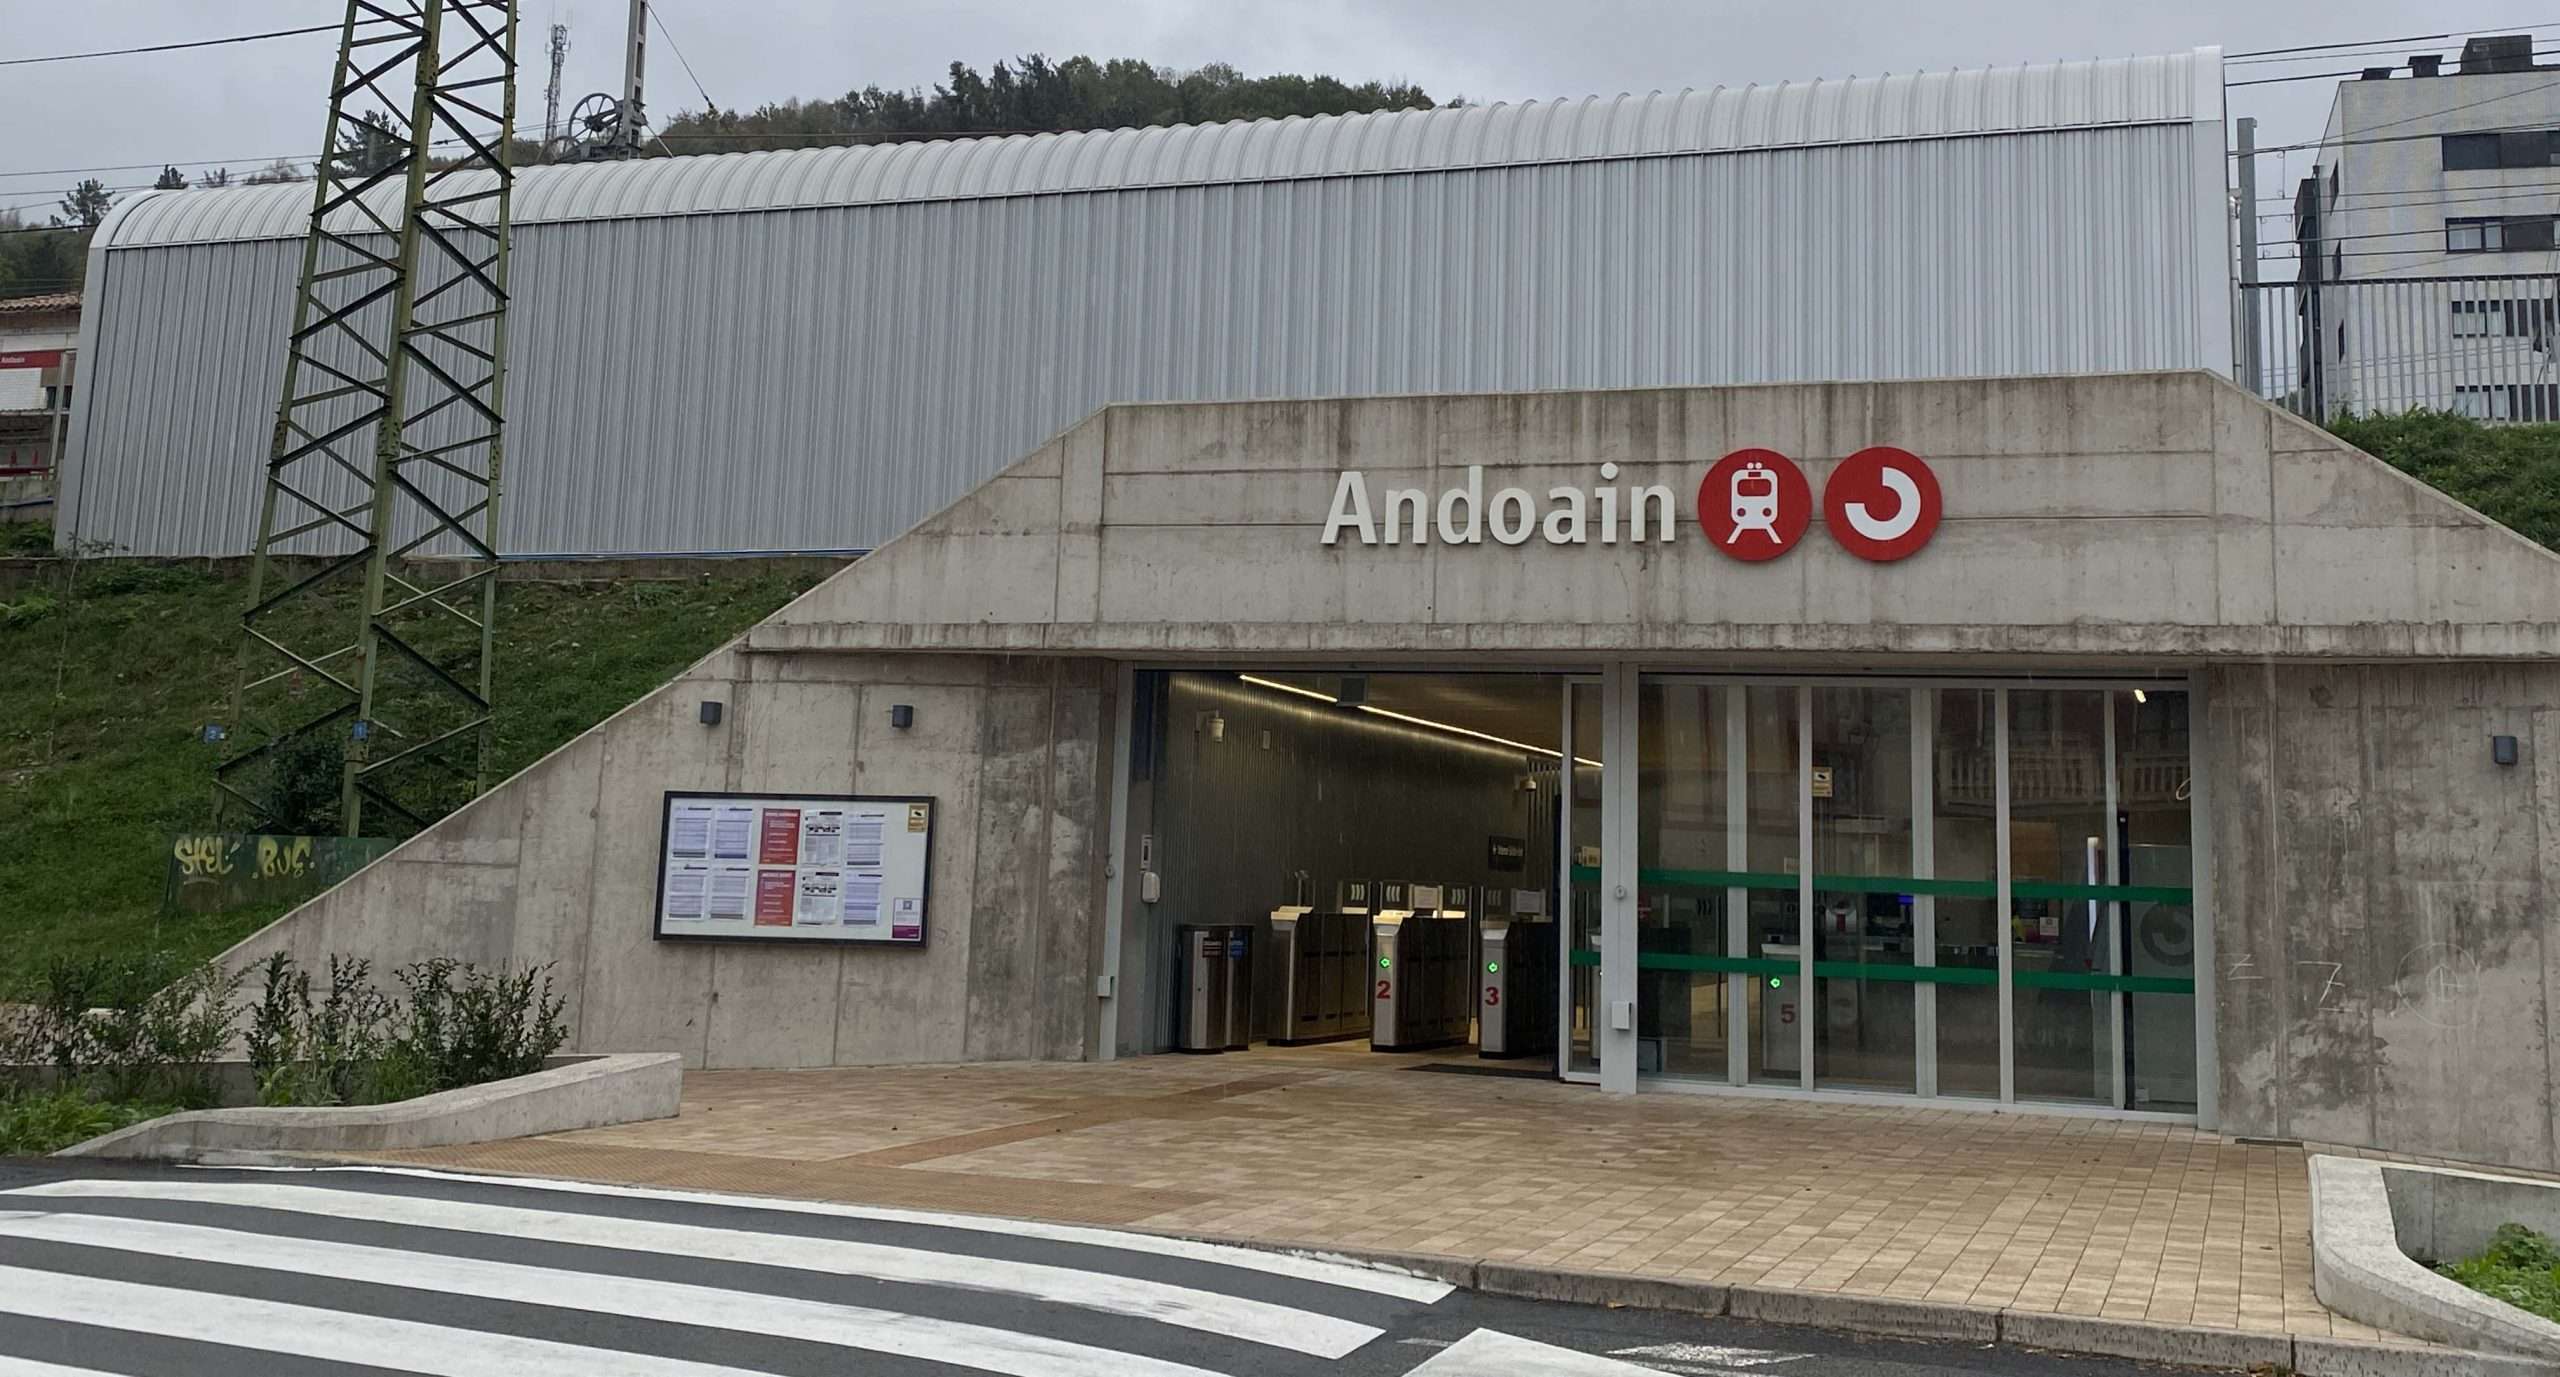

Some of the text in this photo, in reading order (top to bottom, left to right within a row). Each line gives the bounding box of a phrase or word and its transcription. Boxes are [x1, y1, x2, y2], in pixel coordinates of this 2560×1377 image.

[1320, 462, 1676, 545] Andoain
[1376, 980, 1391, 1000] 2
[1484, 986, 1499, 1006] 3
[1781, 1003, 1796, 1024] 5
